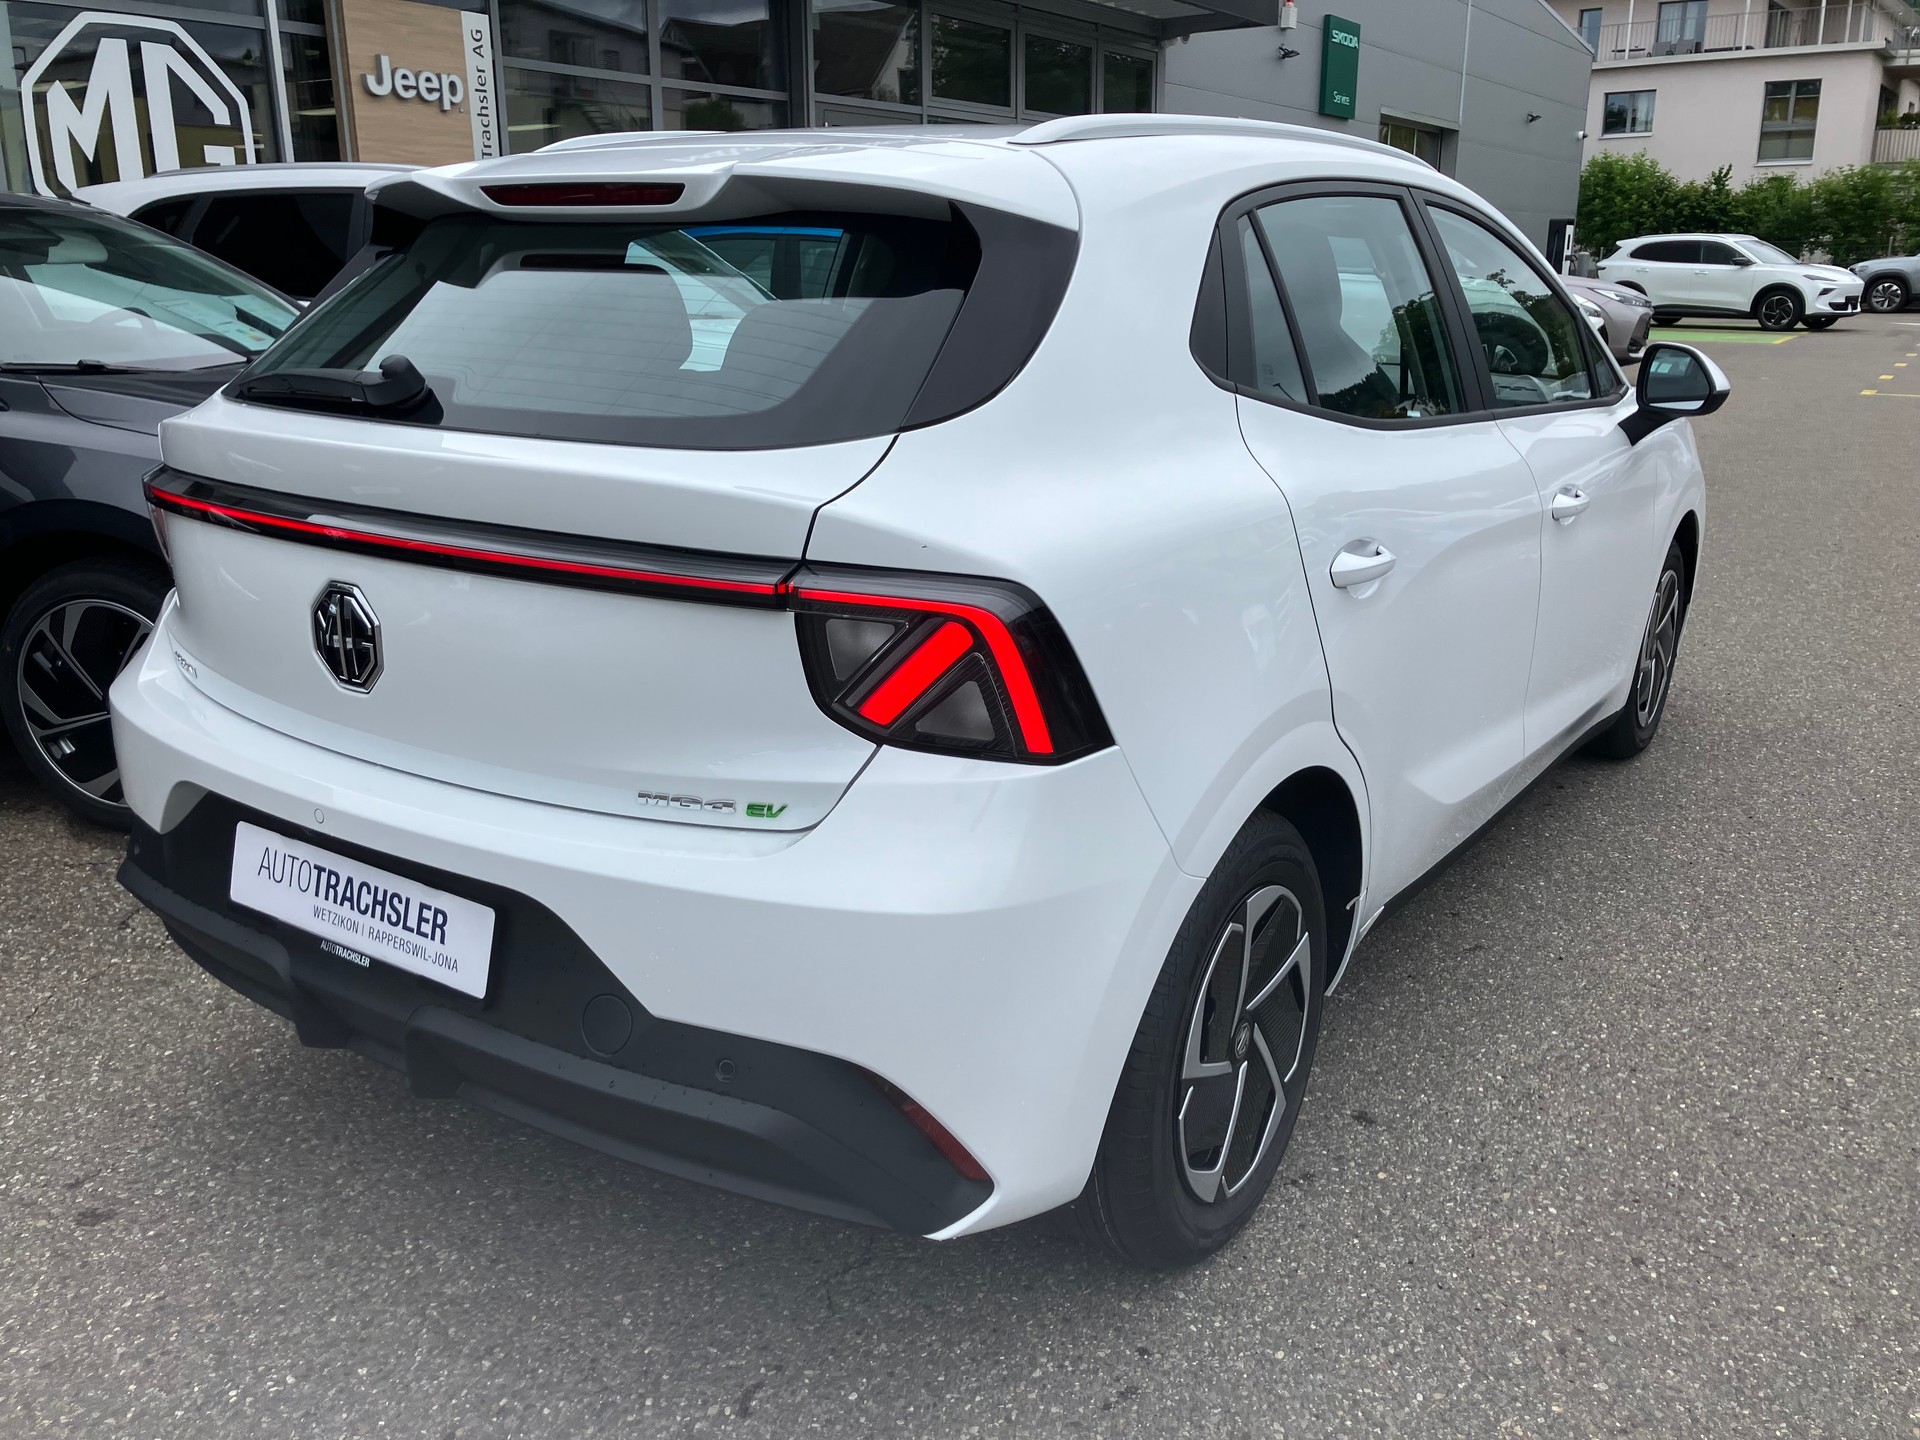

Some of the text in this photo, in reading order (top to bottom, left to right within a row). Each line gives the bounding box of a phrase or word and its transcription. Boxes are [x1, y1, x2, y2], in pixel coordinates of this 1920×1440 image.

[361, 54, 464, 112] Jeep
[470, 29, 493, 159] Trachsler AG
[637, 790, 790, 819] MG4 EV
[257, 846, 449, 945] AUTOTRACHSLER
[313, 904, 459, 973] WETZIKON RAPPERSWIL-JONA
[320, 939, 370, 968] AUTOTRACHSLER
